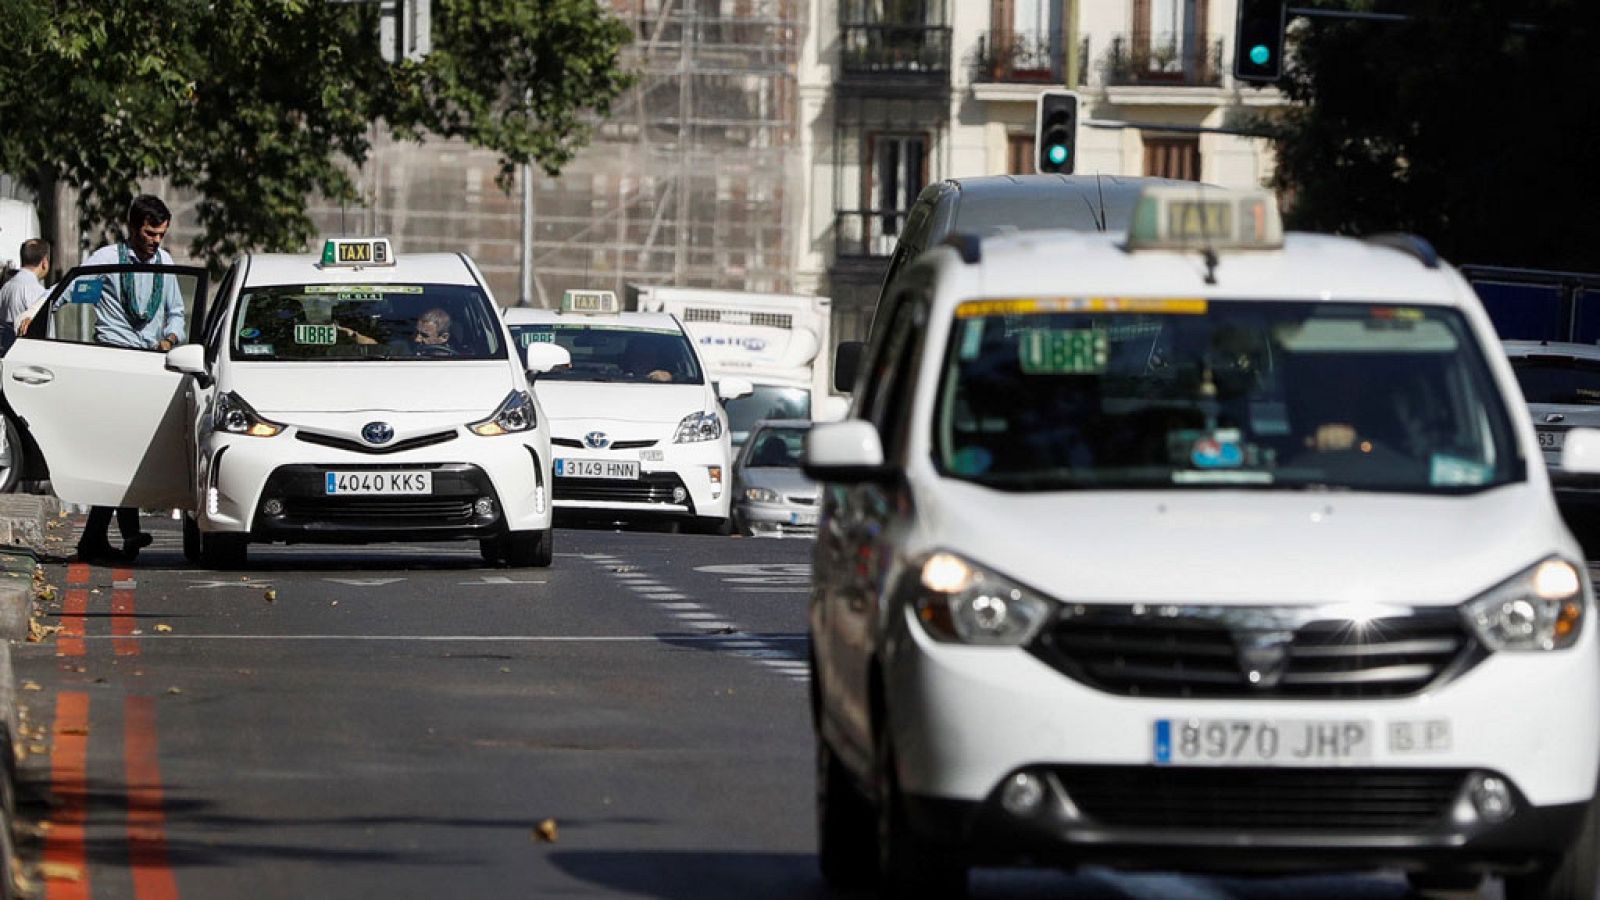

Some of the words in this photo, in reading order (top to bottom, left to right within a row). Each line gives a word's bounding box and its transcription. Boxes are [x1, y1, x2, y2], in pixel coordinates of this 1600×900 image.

[1170, 202, 1231, 237] TAXI
[340, 244, 369, 260] TAXI
[574, 294, 600, 310] TAXI
[296, 325, 335, 343] LIBRE
[1021, 331, 1108, 370] LIBRE
[566, 461, 602, 476] 3149
[607, 463, 634, 477] HNN
[338, 474, 384, 492] 4040
[391, 474, 425, 492] KKS
[1180, 721, 1280, 759] 8970
[1292, 721, 1365, 759] JHP
